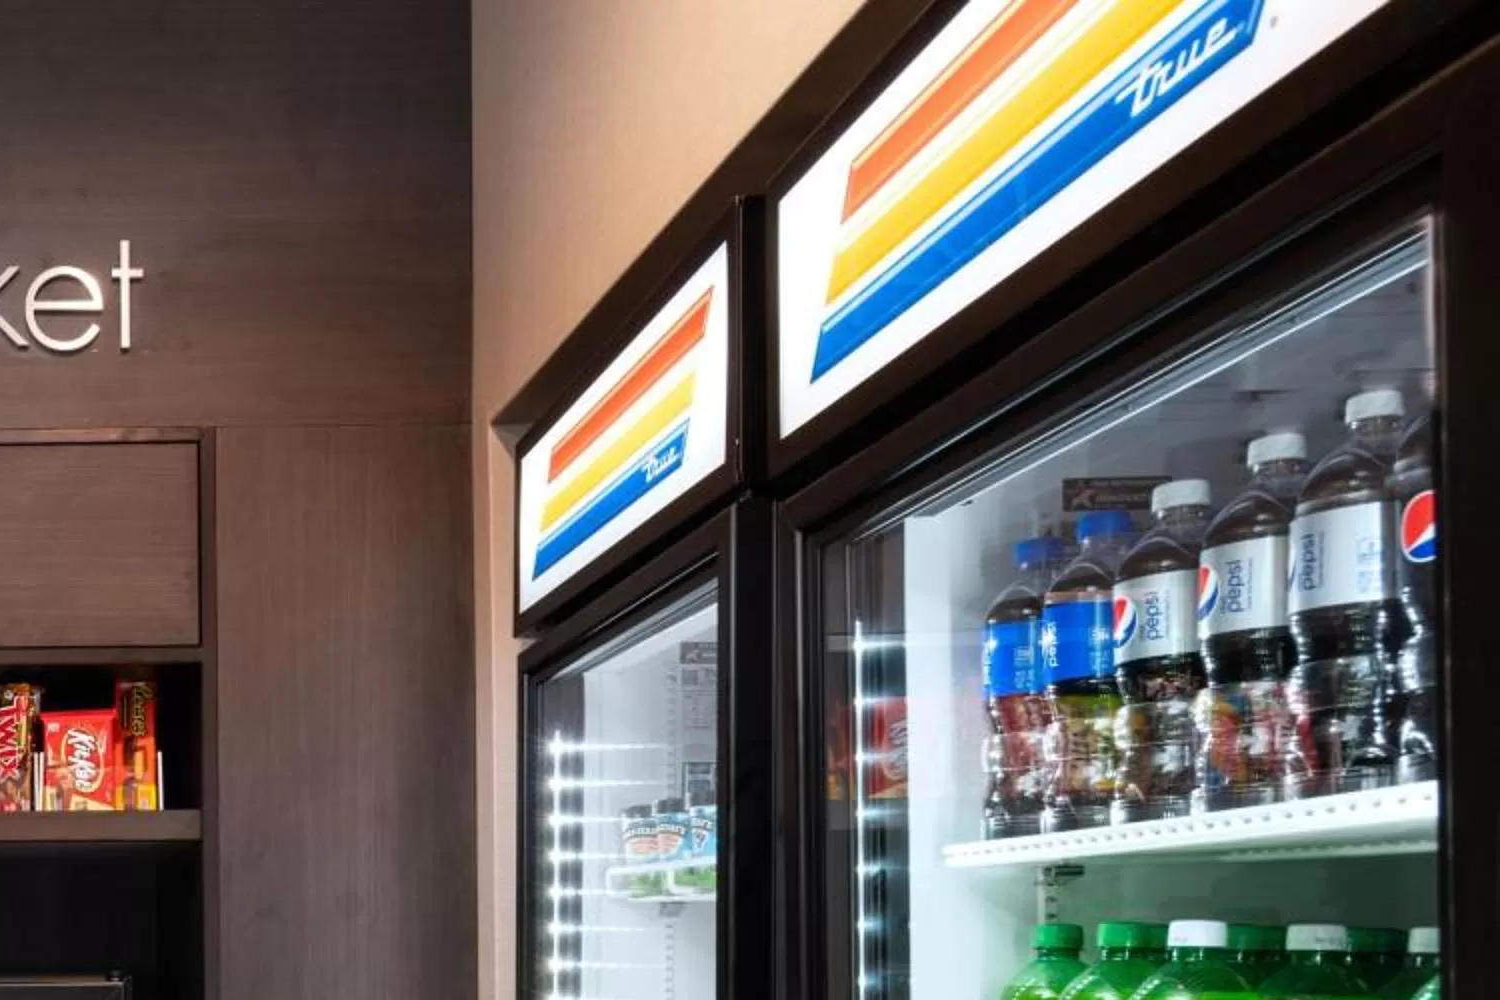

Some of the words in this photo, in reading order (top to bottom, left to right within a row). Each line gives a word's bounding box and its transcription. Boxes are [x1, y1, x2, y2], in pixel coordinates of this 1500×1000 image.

[1226, 560, 1245, 613] pepsi
[1301, 533, 1318, 591] pepsi
[1145, 591, 1164, 640] pepsi
